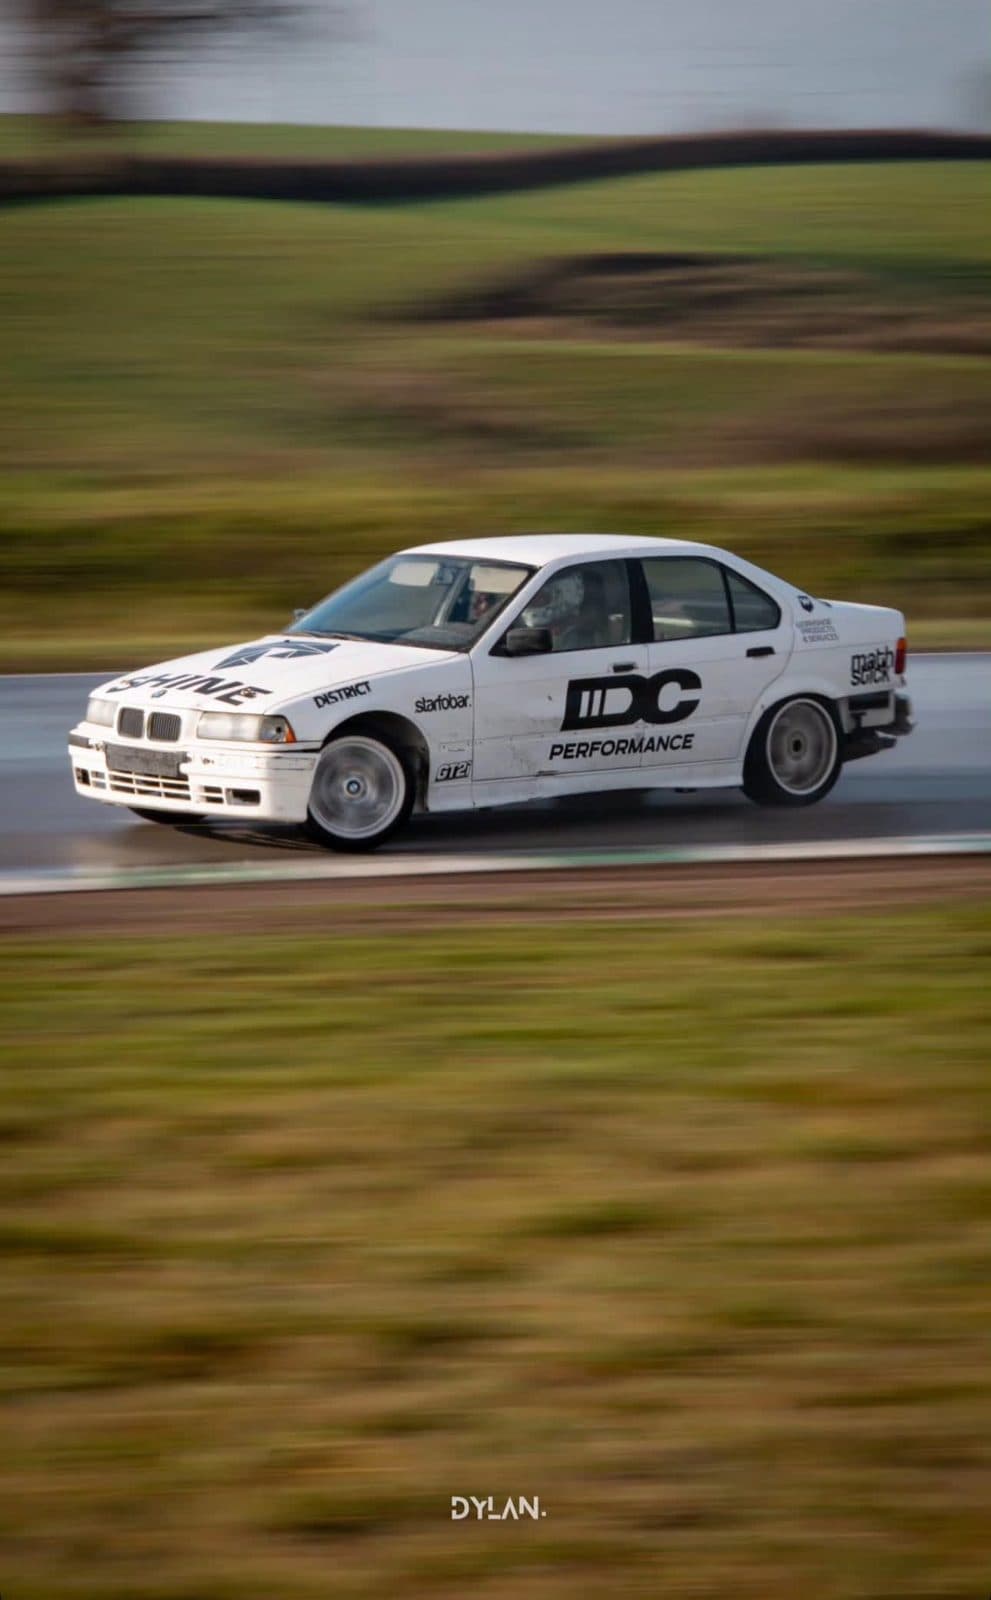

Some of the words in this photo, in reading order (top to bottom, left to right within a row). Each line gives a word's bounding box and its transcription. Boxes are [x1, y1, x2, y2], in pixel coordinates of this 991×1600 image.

[106, 673, 272, 706] SHINE
[313, 680, 372, 709] DISTRICT
[549, 734, 695, 760] PERFORMANCE
